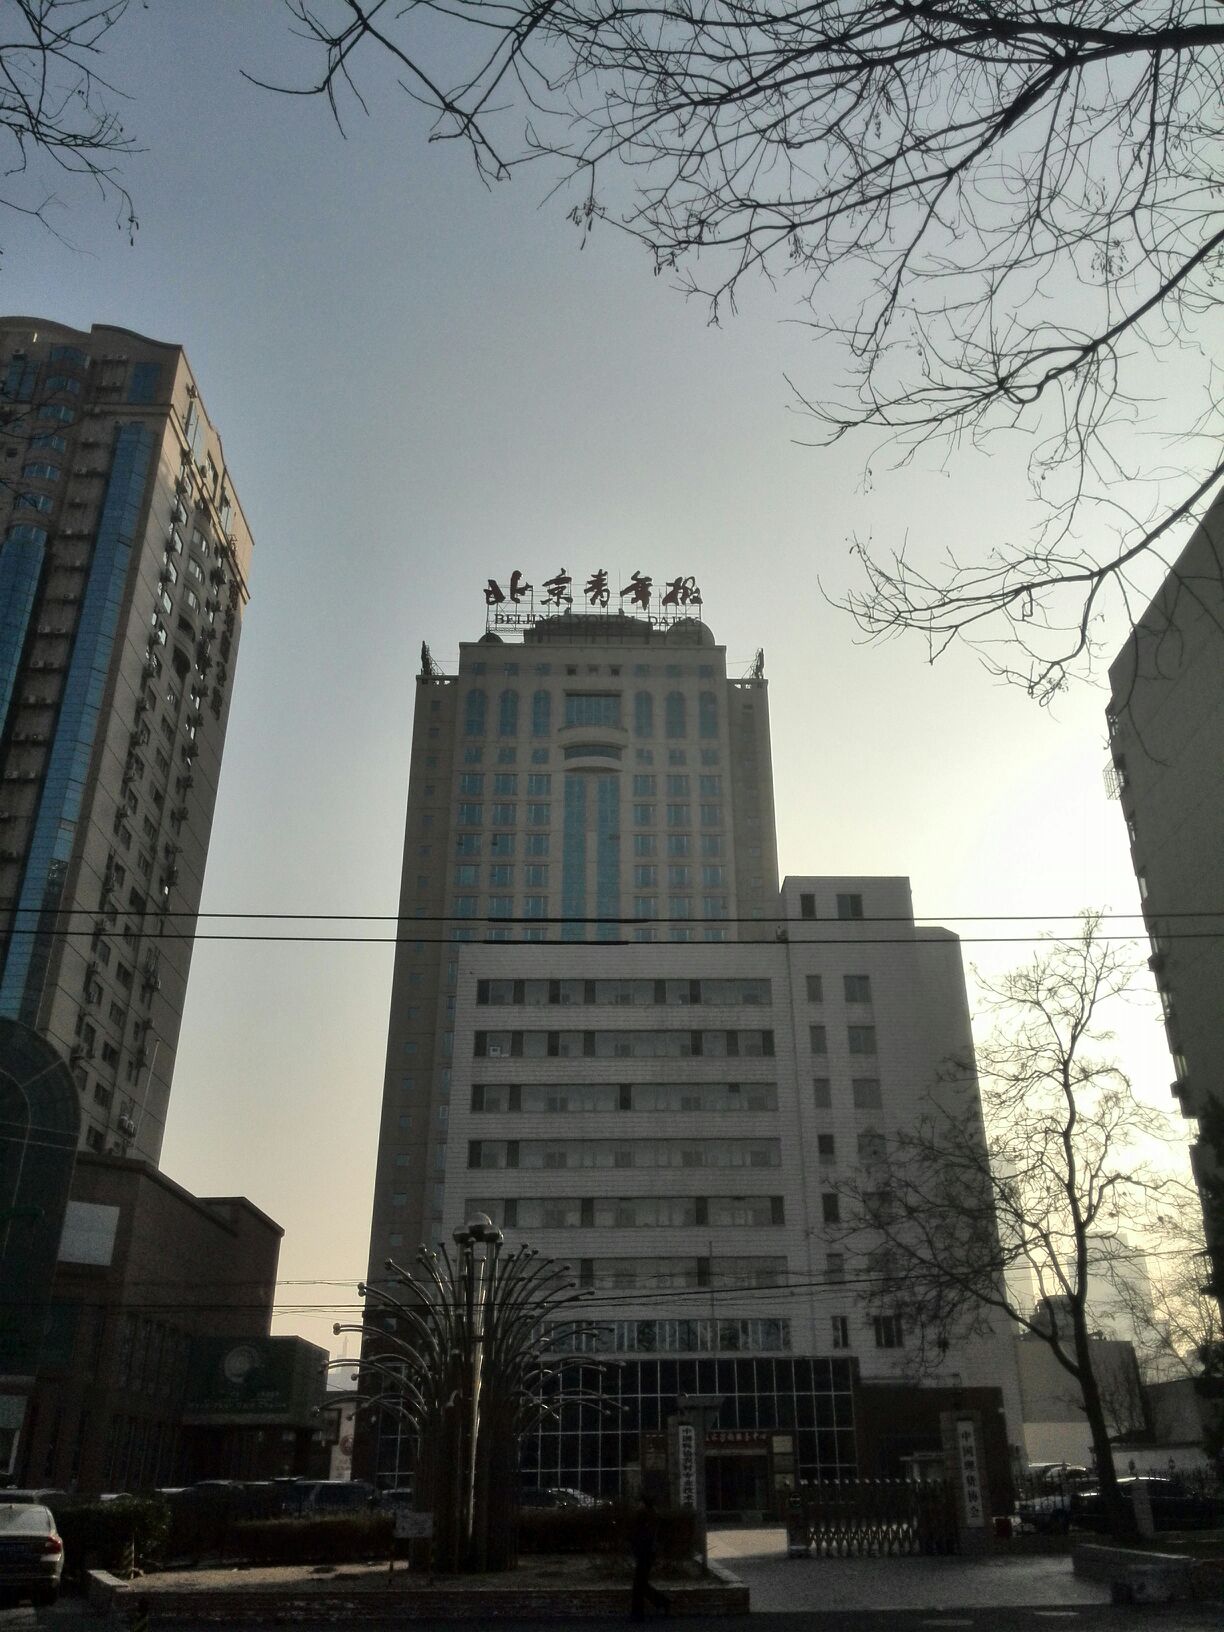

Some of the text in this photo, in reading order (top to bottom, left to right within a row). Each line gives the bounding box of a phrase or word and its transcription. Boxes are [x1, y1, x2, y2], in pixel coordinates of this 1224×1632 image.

[484, 568, 703, 611] 北京青年报
[494, 613, 561, 626] BEIJING
[649, 615, 700, 628] DAILY
